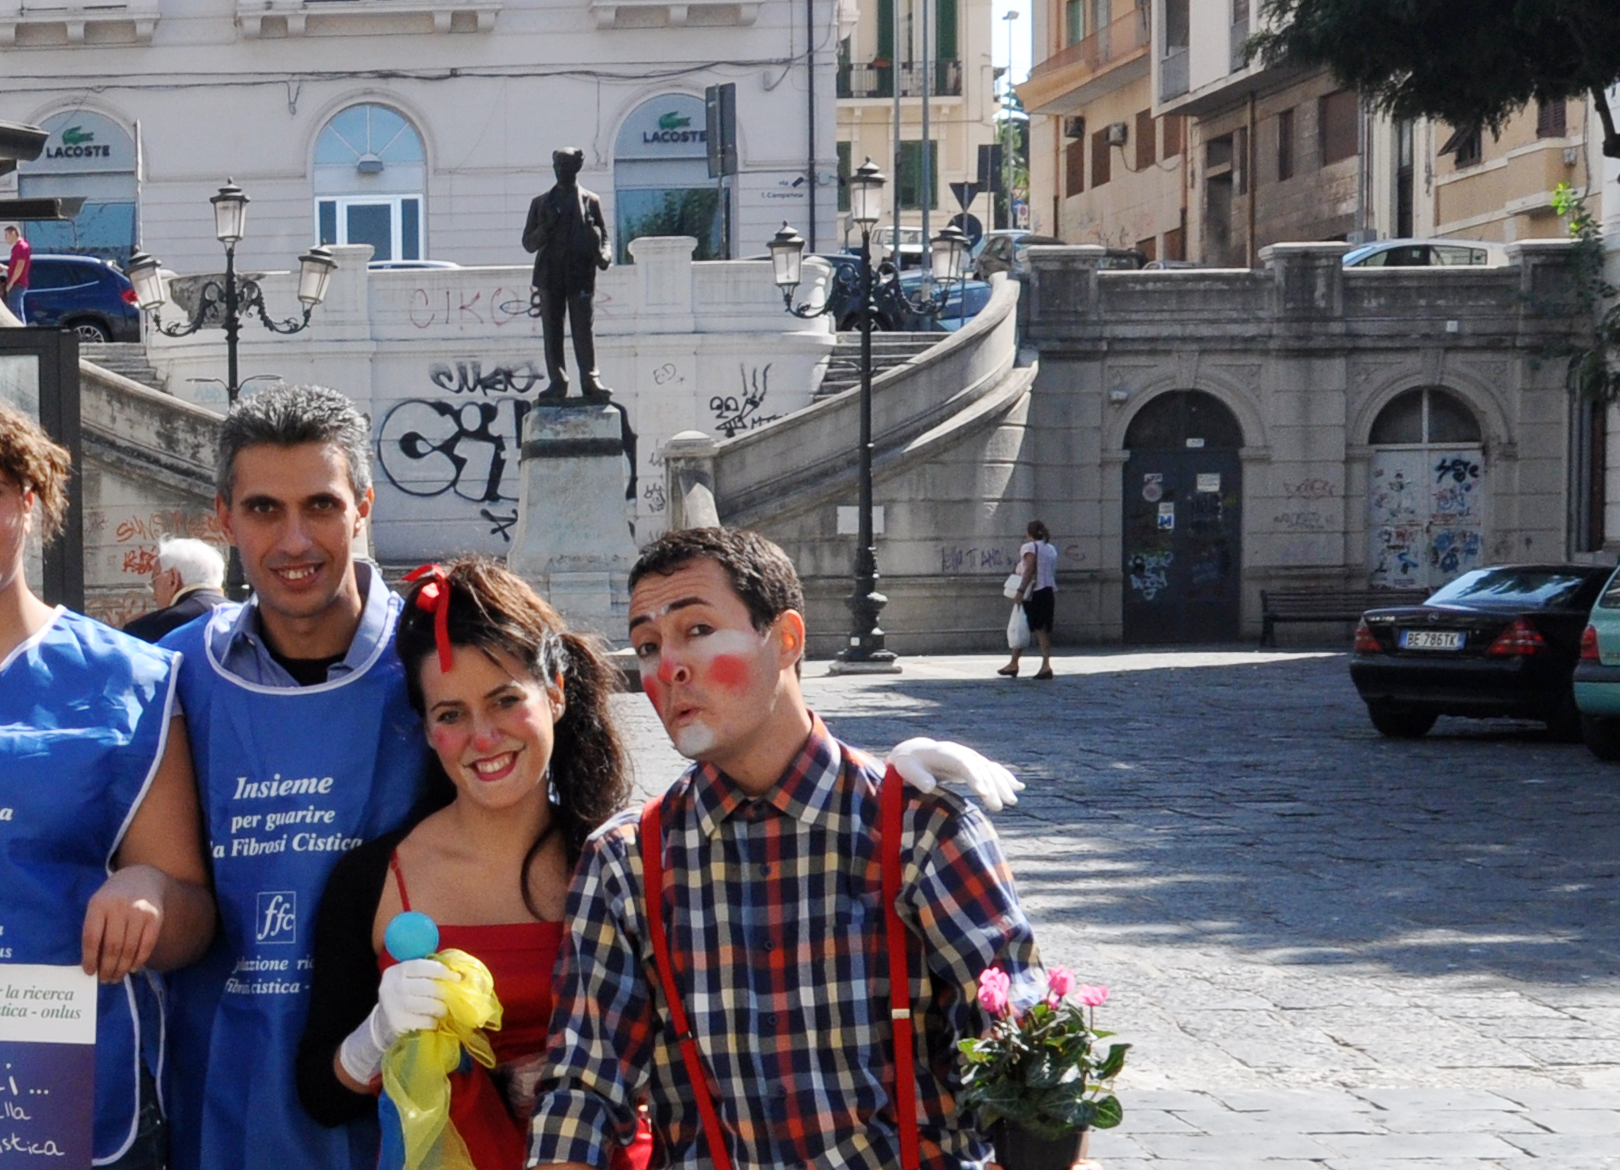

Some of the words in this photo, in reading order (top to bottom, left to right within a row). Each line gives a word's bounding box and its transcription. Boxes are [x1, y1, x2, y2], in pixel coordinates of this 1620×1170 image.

[47, 145, 110, 158] LACOSTE
[233, 773, 334, 800] Insieme
[231, 814, 261, 833] per
[265, 805, 336, 831] guarire
[231, 834, 288, 858] Fibrosi
[257, 895, 295, 940] ffc
[5, 984, 19, 999] la
[22, 985, 75, 1002] ricerca
[41, 1003, 82, 1020] onlus
